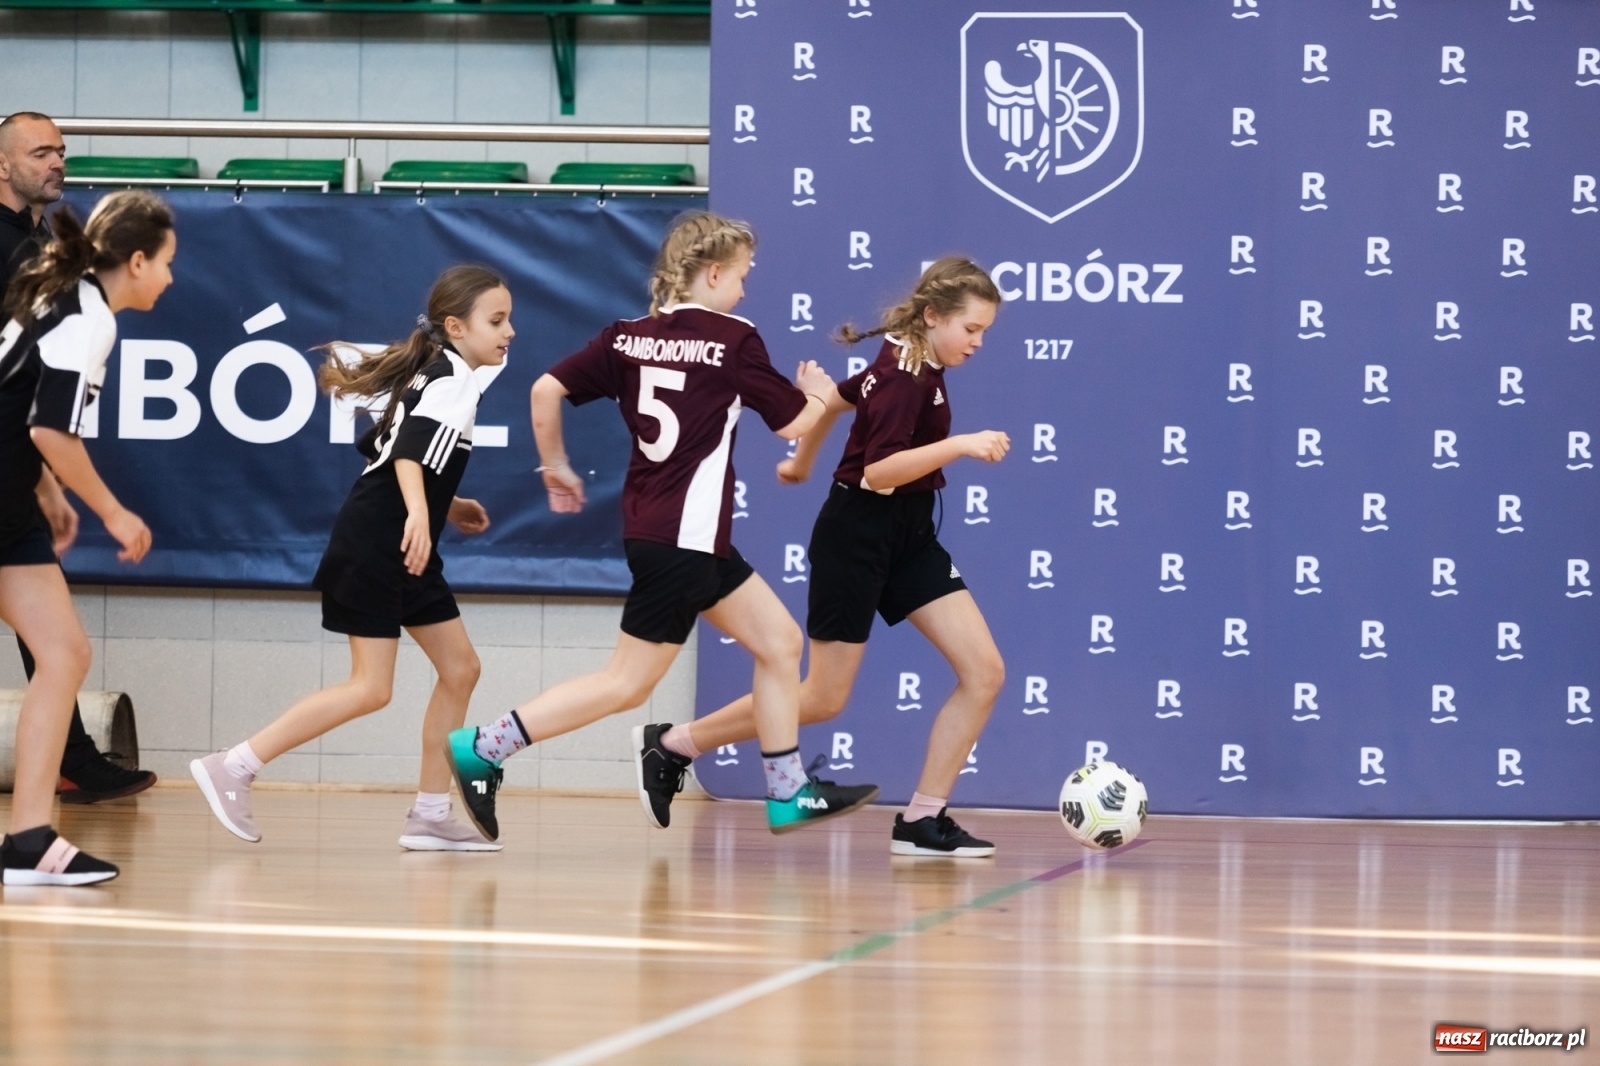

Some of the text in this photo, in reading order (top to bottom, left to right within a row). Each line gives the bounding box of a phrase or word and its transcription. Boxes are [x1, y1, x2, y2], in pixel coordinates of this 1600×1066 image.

[794, 41, 815, 69] R
[1304, 43, 1327, 72] R
[1442, 45, 1465, 73] R
[1578, 47, 1600, 75] R
[735, 104, 755, 132] R
[851, 104, 872, 132] R
[1233, 107, 1256, 135] R
[1369, 108, 1393, 136] R
[1506, 110, 1529, 138] R
[794, 167, 814, 195] R
[1302, 171, 1325, 200] R
[1439, 173, 1462, 201] R
[1574, 174, 1596, 202] R
[850, 230, 871, 258] R
[1231, 235, 1254, 263] R
[1367, 236, 1390, 264] R
[1503, 237, 1525, 266] R
[920, 249, 1184, 303] CIBÓRZ
[792, 292, 812, 321] R
[1300, 299, 1323, 328] R
[1436, 301, 1459, 329] R
[1571, 302, 1593, 330] R
[612, 334, 726, 367] SAMBOROWICE
[1025, 338, 1074, 360] 1217
[1229, 362, 1252, 391] R
[1365, 364, 1388, 392] R
[1500, 366, 1523, 394] R
[637, 365, 687, 463] 5
[1034, 423, 1056, 451] R
[1164, 425, 1187, 454] R
[1298, 427, 1321, 456] R
[1434, 429, 1457, 457] R
[1569, 430, 1591, 458] R
[966, 485, 988, 513] R
[1095, 487, 1117, 516] R
[1227, 490, 1250, 519] R
[1363, 492, 1386, 520] R
[1499, 494, 1521, 522] R
[785, 543, 805, 572] R
[1030, 549, 1052, 578] R
[1161, 552, 1184, 581] R
[1296, 555, 1320, 583] R
[1433, 557, 1456, 585] R
[1568, 558, 1590, 586] R
[1091, 614, 1114, 643] R
[1225, 617, 1248, 645] R
[1362, 620, 1385, 648] R
[1498, 621, 1521, 649] R
[899, 672, 920, 700] R
[1025, 675, 1048, 704] R
[1158, 679, 1181, 707] R
[1295, 682, 1318, 710] R
[1432, 684, 1456, 712] R
[1568, 685, 1591, 713] R
[832, 731, 853, 759] R
[1085, 740, 1108, 766] R
[1222, 743, 1245, 771] R
[1361, 746, 1384, 774] R
[1499, 748, 1522, 775] R
[796, 797, 829, 810] FILA
